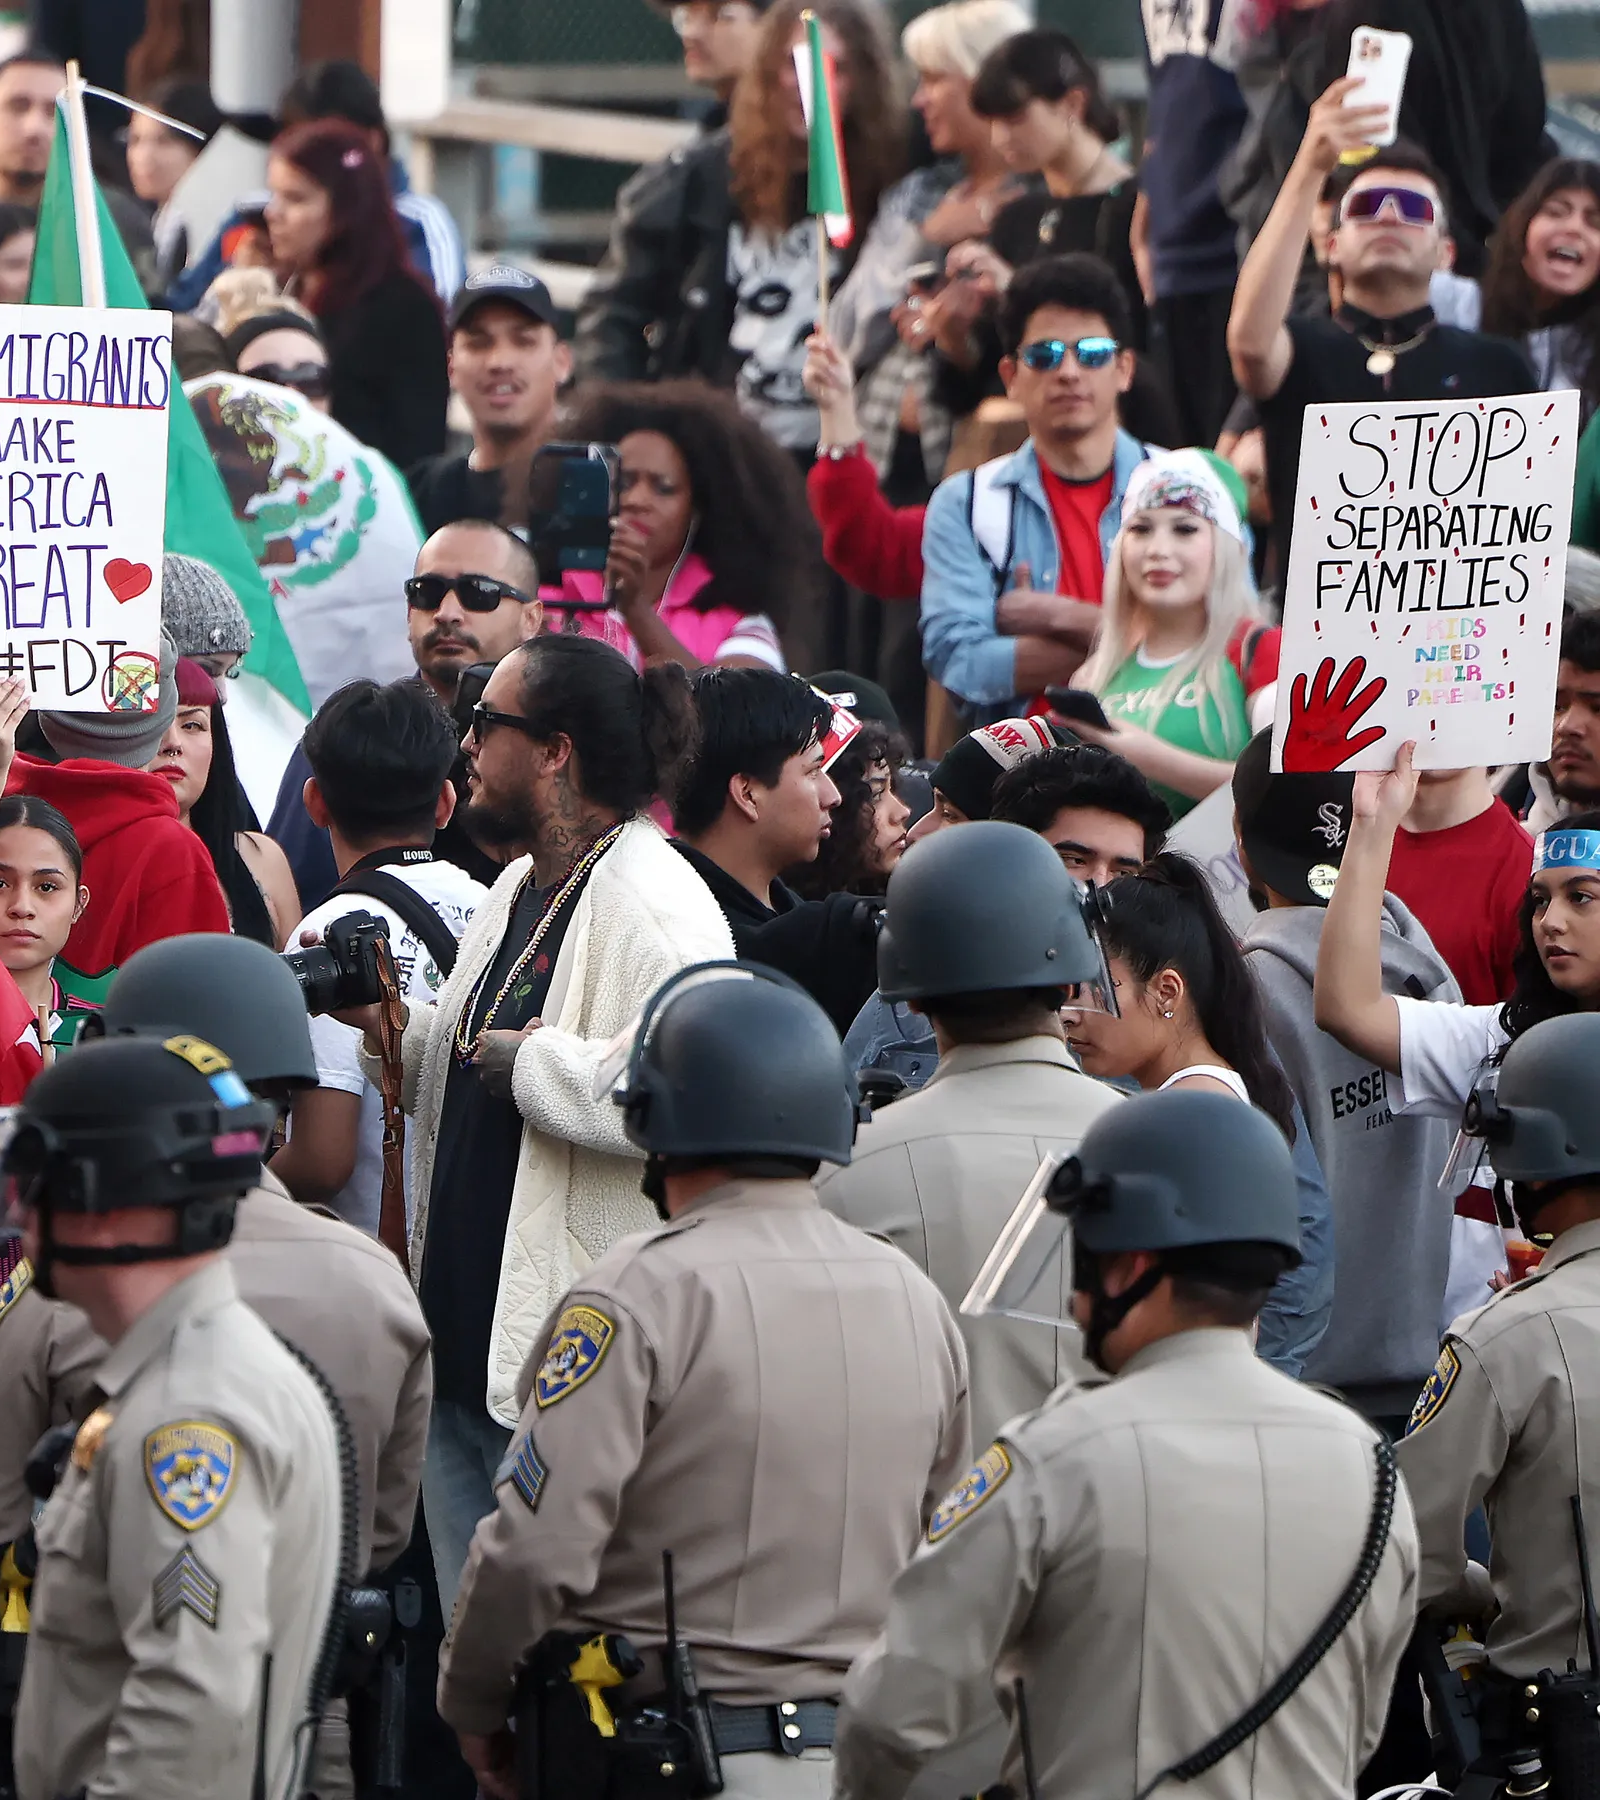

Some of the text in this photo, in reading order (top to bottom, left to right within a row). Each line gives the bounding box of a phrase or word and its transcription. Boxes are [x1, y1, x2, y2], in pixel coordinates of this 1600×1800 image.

[1338, 407, 1527, 498] STOP
[1326, 503, 1553, 551] SEPARATING
[1426, 617, 1487, 640] KIDS
[1415, 643, 1481, 663] NEED
[403, 850, 433, 862] Canon
[1365, 1107, 1394, 1131] FEAR
